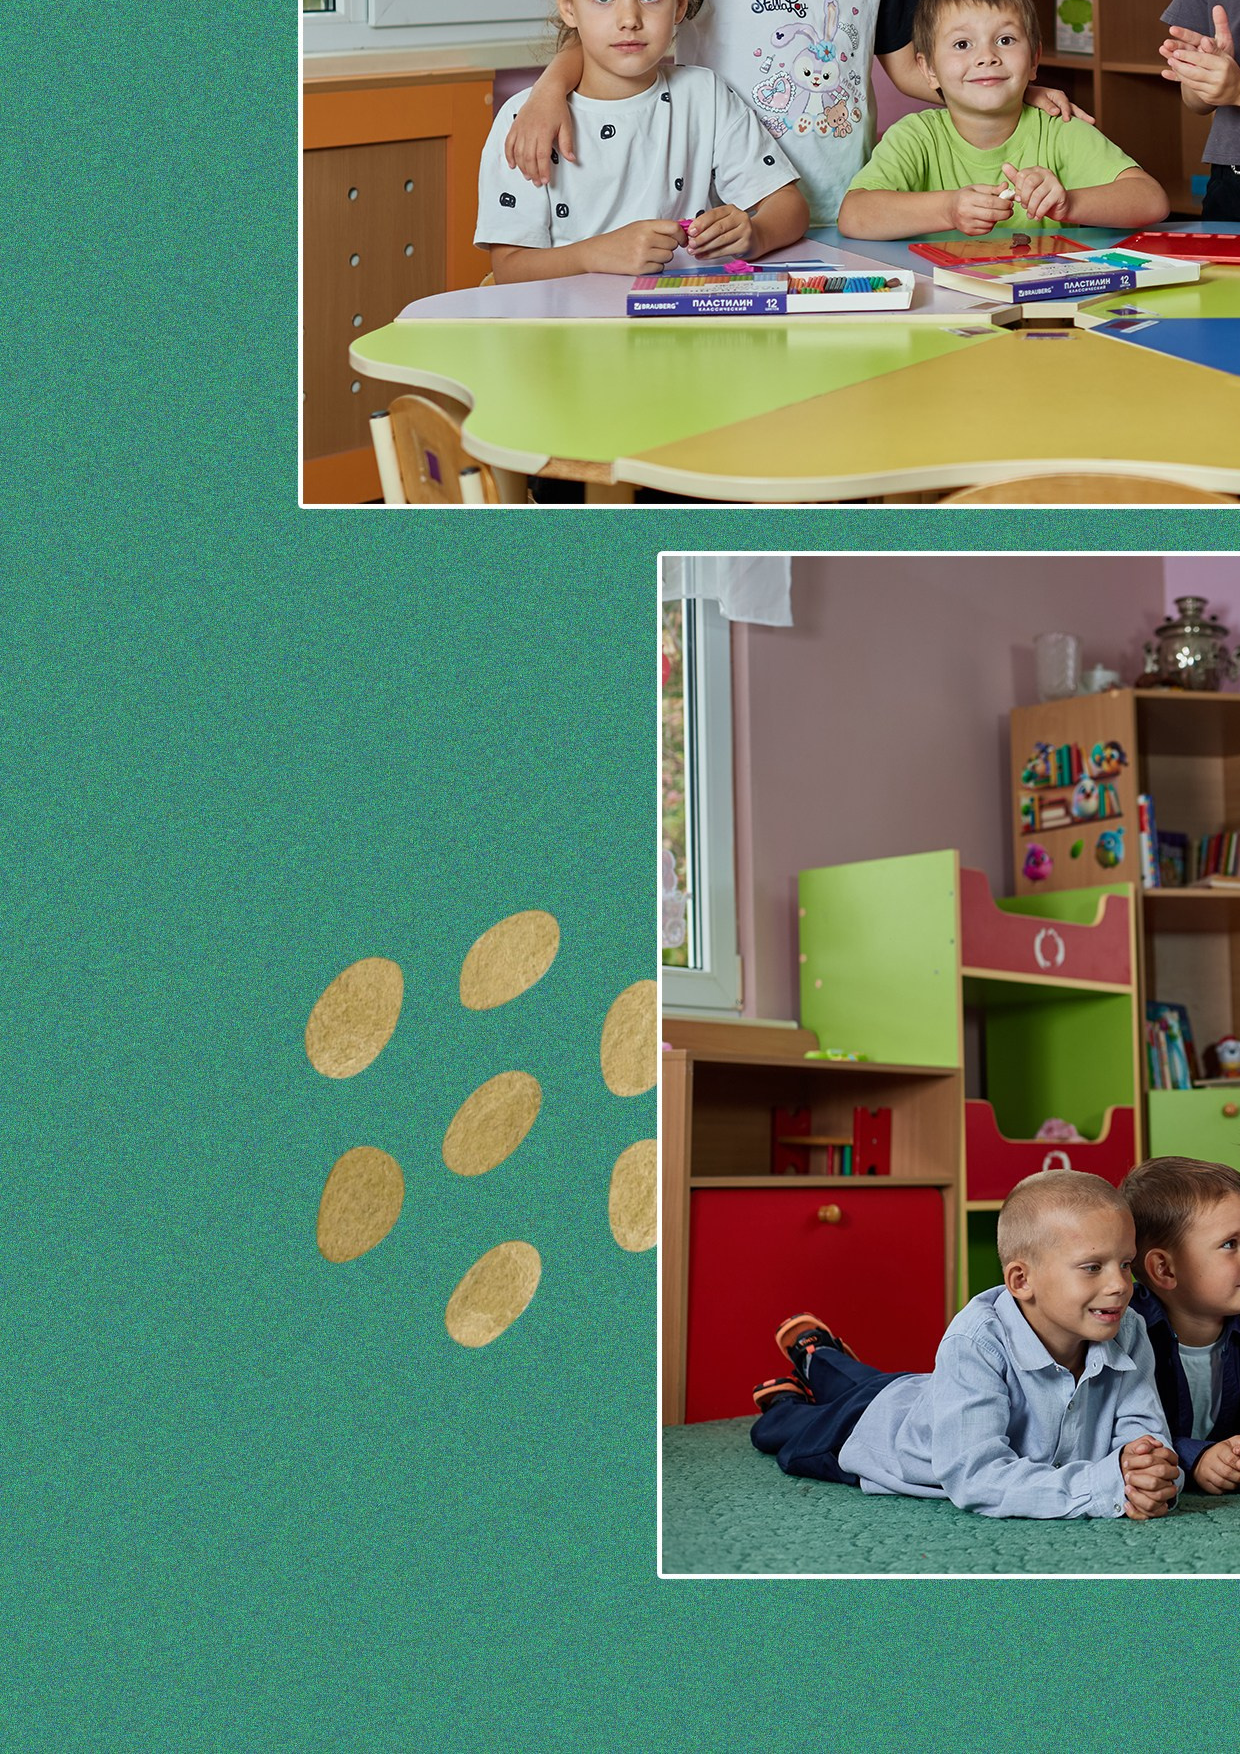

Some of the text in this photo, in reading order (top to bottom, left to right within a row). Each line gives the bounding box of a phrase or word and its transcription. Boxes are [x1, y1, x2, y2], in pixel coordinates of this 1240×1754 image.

[1064, 277, 1111, 290] ПЛАСТИЛИН
[1120, 276, 1130, 285] 12
[1069, 285, 1106, 294] КЛАССИЧЕСКИЙ
[692, 299, 753, 308] ПЛАСТИЛИН
[766, 298, 778, 308] 12
